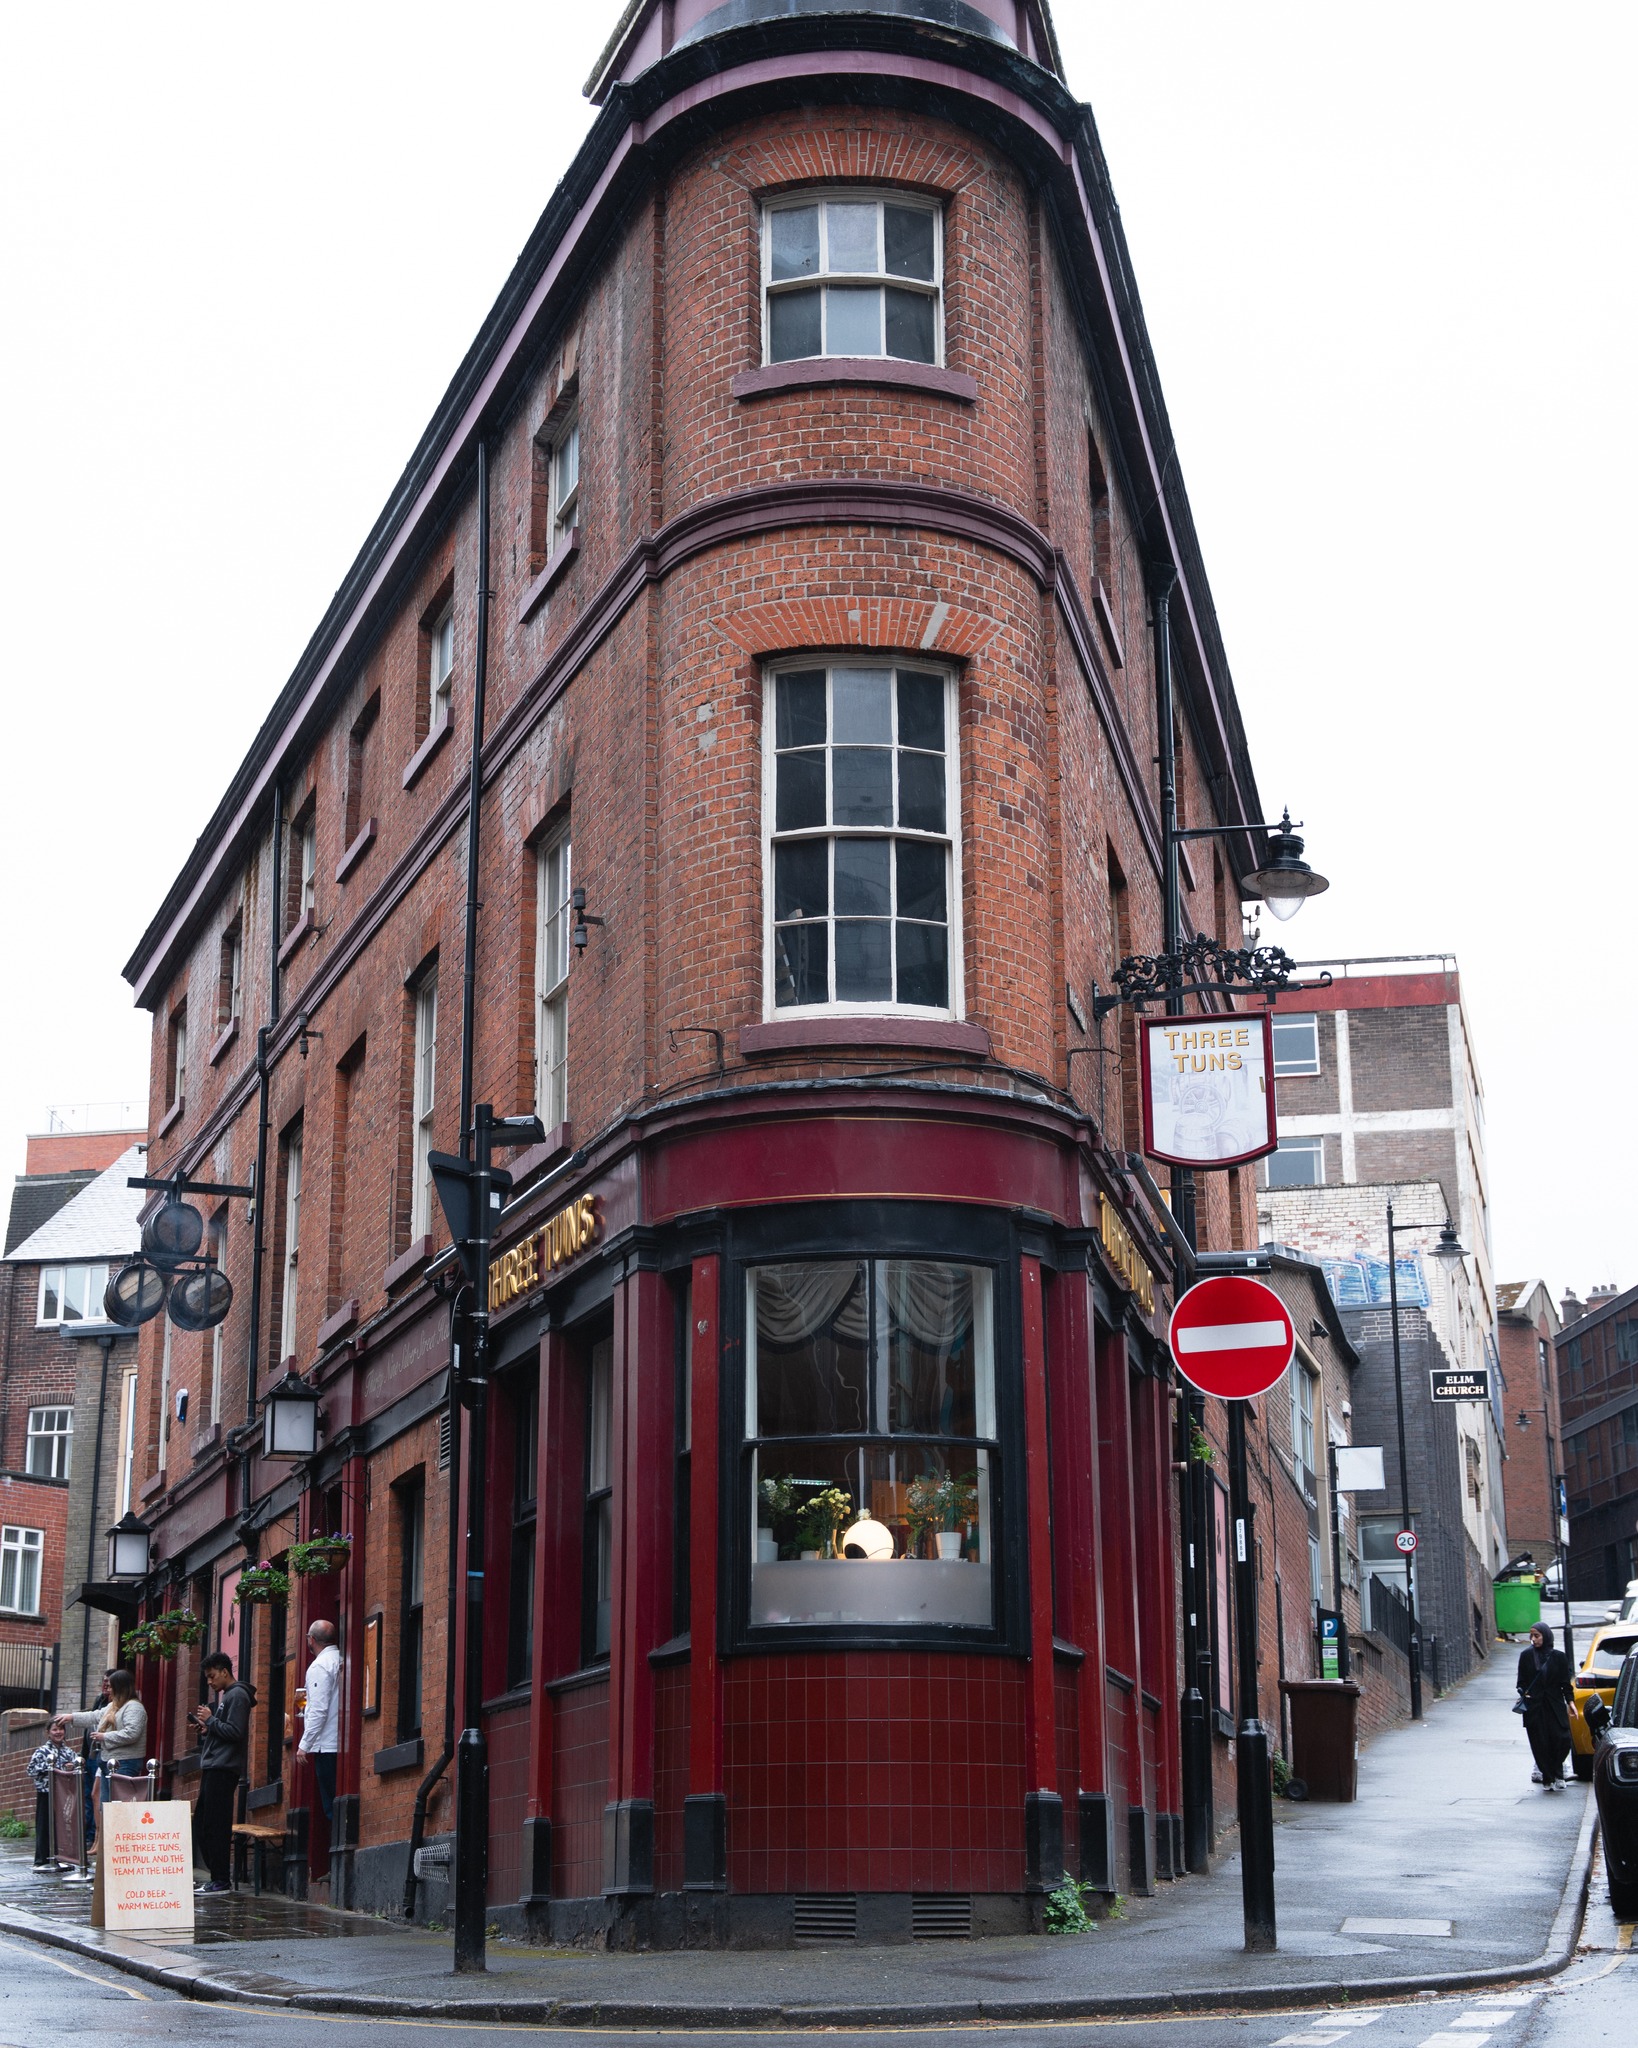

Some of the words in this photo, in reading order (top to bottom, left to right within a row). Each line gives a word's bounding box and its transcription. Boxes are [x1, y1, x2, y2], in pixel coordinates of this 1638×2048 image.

[1164, 1028, 1249, 1050] THREE
[1173, 1052, 1243, 1073] TUNS
[540, 1193, 595, 1271] TUNS
[1446, 1375, 1474, 1384] ELIM
[1436, 1385, 1484, 1395] CHURCH
[1399, 1536, 1414, 1546] 20
[1324, 1620, 1334, 1636] P
[115, 1833, 121, 1841] A
[122, 1833, 146, 1841] FRESH
[132, 1844, 156, 1852] THREE
[112, 1856, 131, 1864] WITH
[152, 1855, 169, 1863] AND
[113, 1868, 135, 1876] TEAM
[162, 1866, 184, 1874] HELM
[125, 1890, 145, 1899] COLD
[147, 1890, 166, 1898] BEER
[117, 1902, 142, 1910] WARM
[143, 1901, 181, 1910] WELCOME
